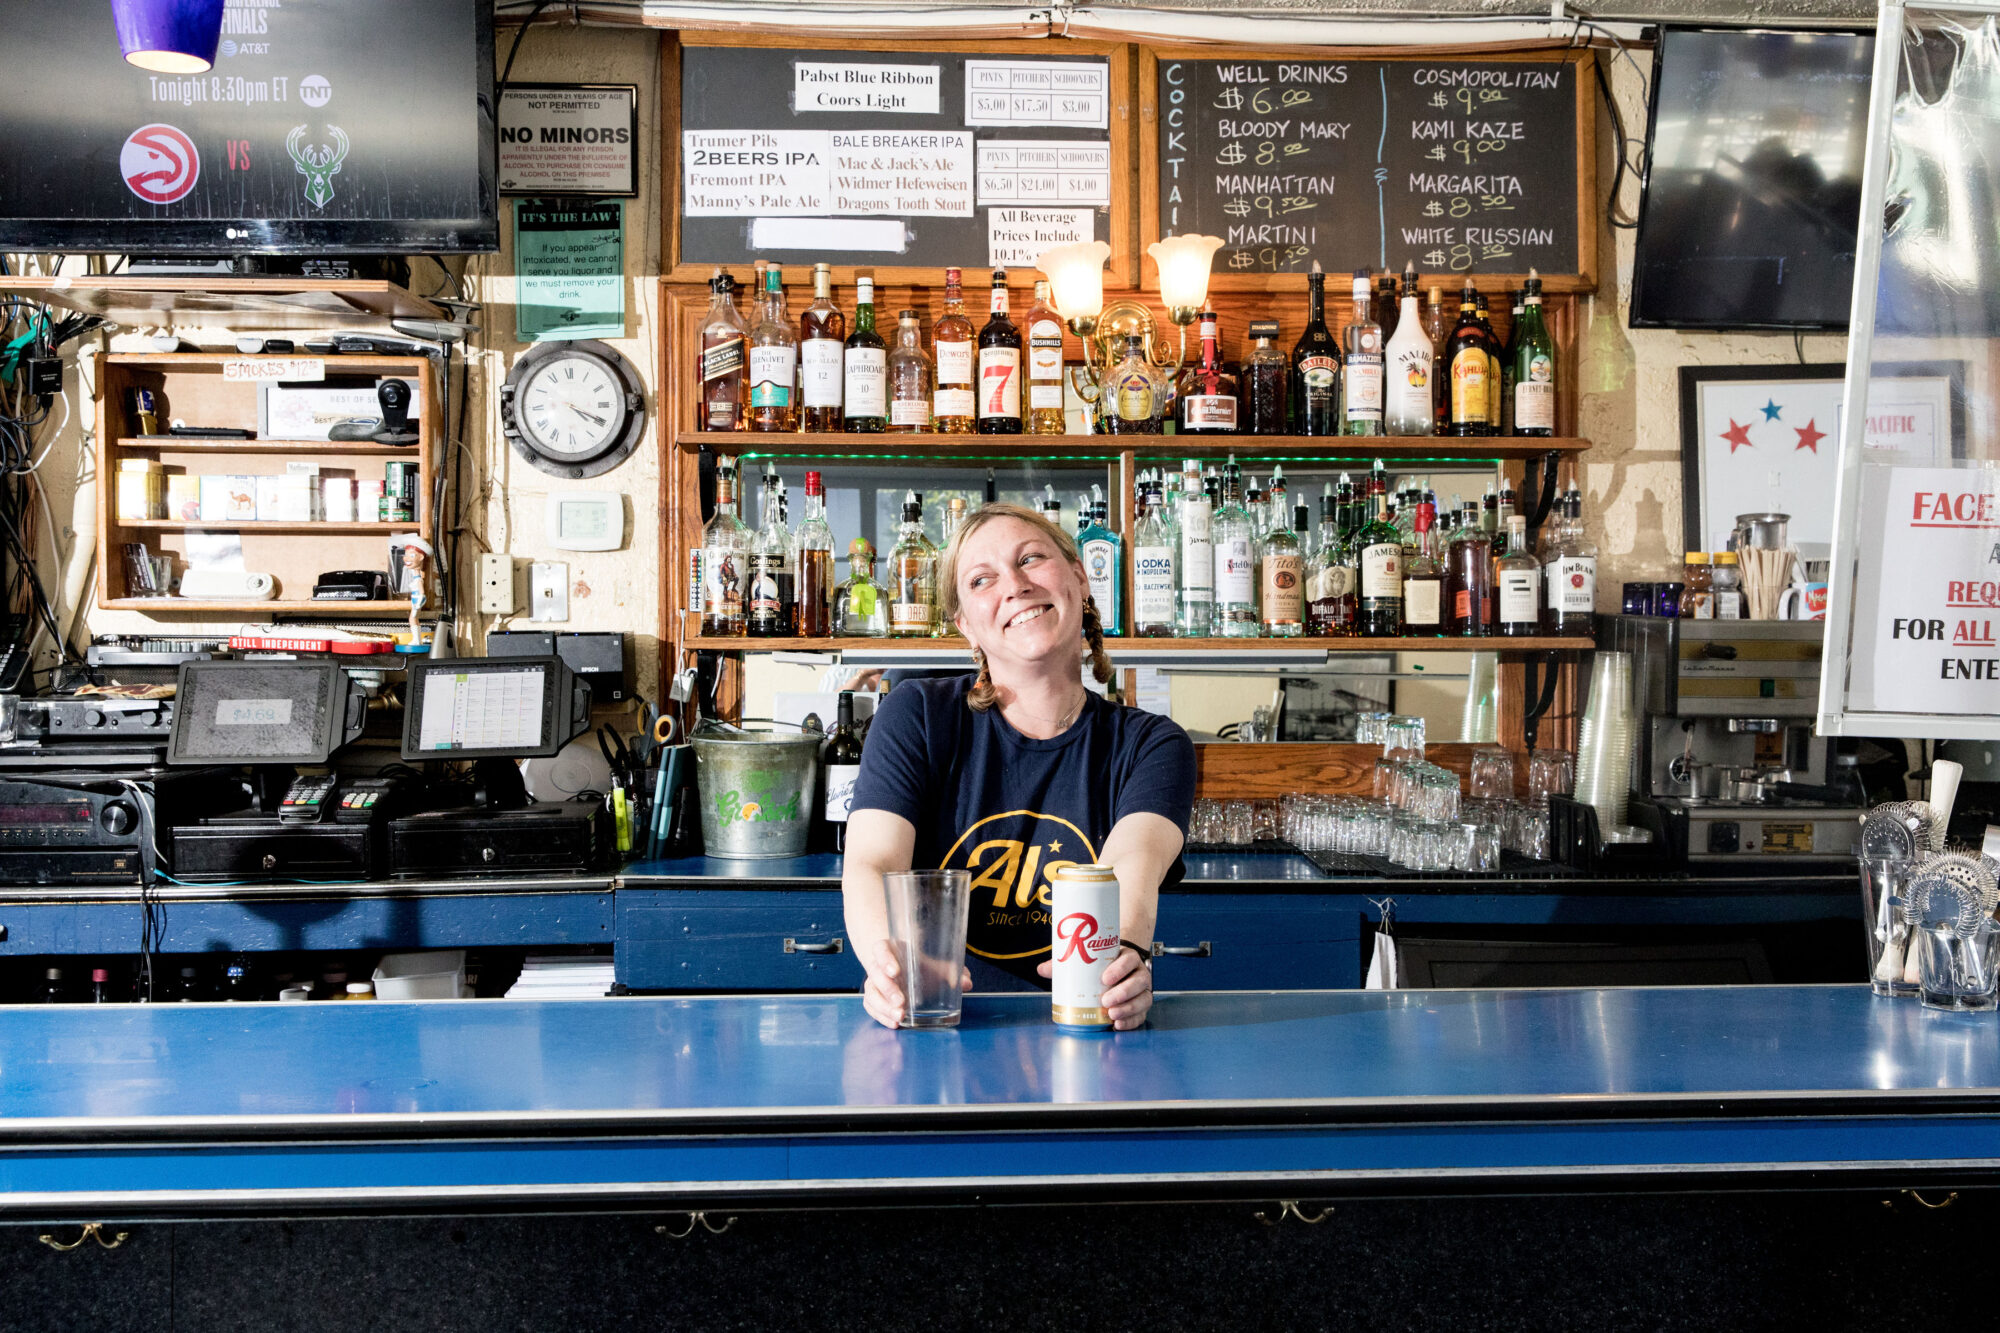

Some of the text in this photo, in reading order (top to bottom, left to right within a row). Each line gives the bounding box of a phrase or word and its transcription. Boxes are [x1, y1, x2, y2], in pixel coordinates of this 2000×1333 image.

[239, 43, 270, 55] AT&T
[800, 69, 933, 86] Pabst Blue Ribbon
[980, 72, 1098, 84] PINTS PITCHERS SCHOONERS
[1216, 65, 1348, 84] WELL DRINKS
[1413, 68, 1560, 89] COSMOPOLITAN
[149, 76, 288, 106] Tonight 8:30pm ET
[528, 101, 600, 109] NOT PERMITTED
[817, 92, 907, 110] Coors Light
[977, 98, 1090, 113] $5.00 $17.50 $3.00
[500, 127, 629, 144] NO MINORS
[1218, 119, 1350, 140] BLOODY MARY
[1412, 120, 1525, 140] KAMI KAZE
[688, 134, 778, 147] Trumer Pils
[833, 136, 964, 148] BALE BREAKER IPA
[227, 140, 250, 171] VS
[986, 151, 1010, 162] PINTS
[1019, 152, 1056, 162] PITCHERS
[1166, 63, 1187, 237] COCKTAI
[693, 150, 820, 166] 2BEERS IPA
[837, 157, 867, 170] Mac
[870, 158, 883, 170] &
[930, 159, 954, 171] Ale
[690, 173, 787, 186] Fremont IPA
[838, 177, 968, 191] Widmer Hefeweisen
[984, 178, 1012, 192] $6.50
[1216, 174, 1335, 195] MANHATTAN
[1409, 173, 1523, 196] MARGARITA
[760, 195, 792, 208] Pale
[795, 195, 821, 208] Ale
[838, 196, 967, 212] Dragons Tooth Stout
[522, 212, 547, 223] IT'S
[550, 212, 578, 223] THE
[582, 211, 612, 222] LAW
[998, 210, 1077, 224] All Beverage
[993, 229, 1081, 242] Prices Include
[1228, 224, 1316, 245] MARTINI
[1401, 227, 1553, 246] WHITE RUSSIAN
[542, 244, 598, 254] If you appear
[993, 247, 1032, 261] 10.1%
[523, 256, 571, 265] intoxicated,
[588, 255, 617, 263] cannot
[528, 266, 613, 277] serve you liquor and
[525, 278, 616, 289] we must remove your
[995, 296, 1004, 310] 7
[1031, 339, 1061, 347] BUSHMILLS
[226, 361, 286, 379] SMOKES
[1301, 357, 1337, 372] BAILEYS
[861, 384, 870, 393] 10
[983, 365, 1014, 413] 7
[1866, 415, 1915, 434] ACIFIC
[1912, 492, 1996, 522] FACE
[1368, 548, 1399, 560] JAMES
[1136, 559, 1171, 568] VODKA
[1948, 581, 2000, 608] REQ
[1892, 618, 1997, 642] FOR ALL
[232, 637, 323, 651] STILL INDEPENDENT
[1057, 911, 1120, 965] Rainier
